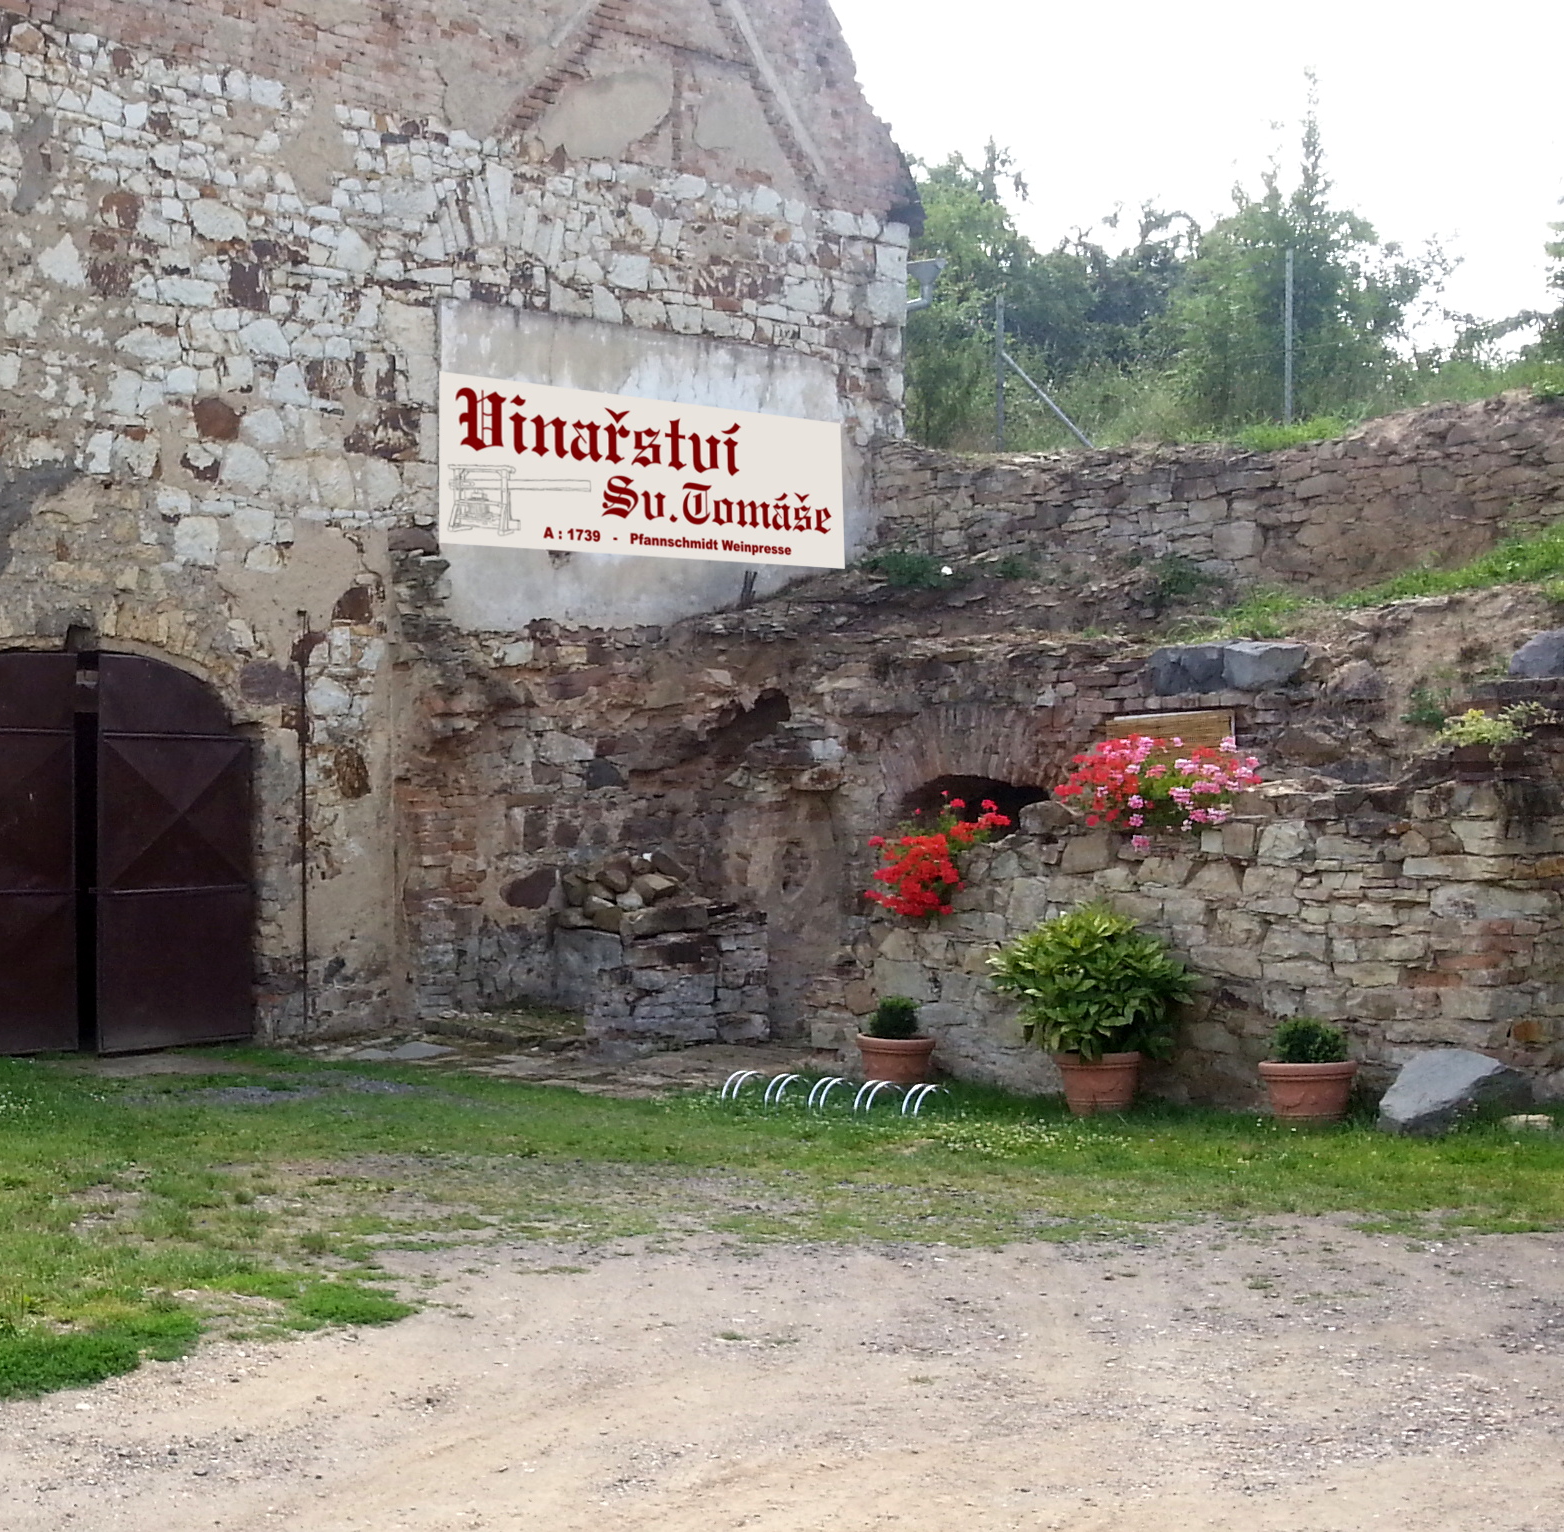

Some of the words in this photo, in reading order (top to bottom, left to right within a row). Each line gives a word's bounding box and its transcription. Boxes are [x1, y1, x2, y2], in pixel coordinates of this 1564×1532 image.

[455, 387, 741, 476] Vinařství
[543, 526, 555, 539] A
[567, 528, 601, 543] 1739
[629, 532, 719, 551] Pfannschmidt
[722, 539, 792, 556] Weinpresse
